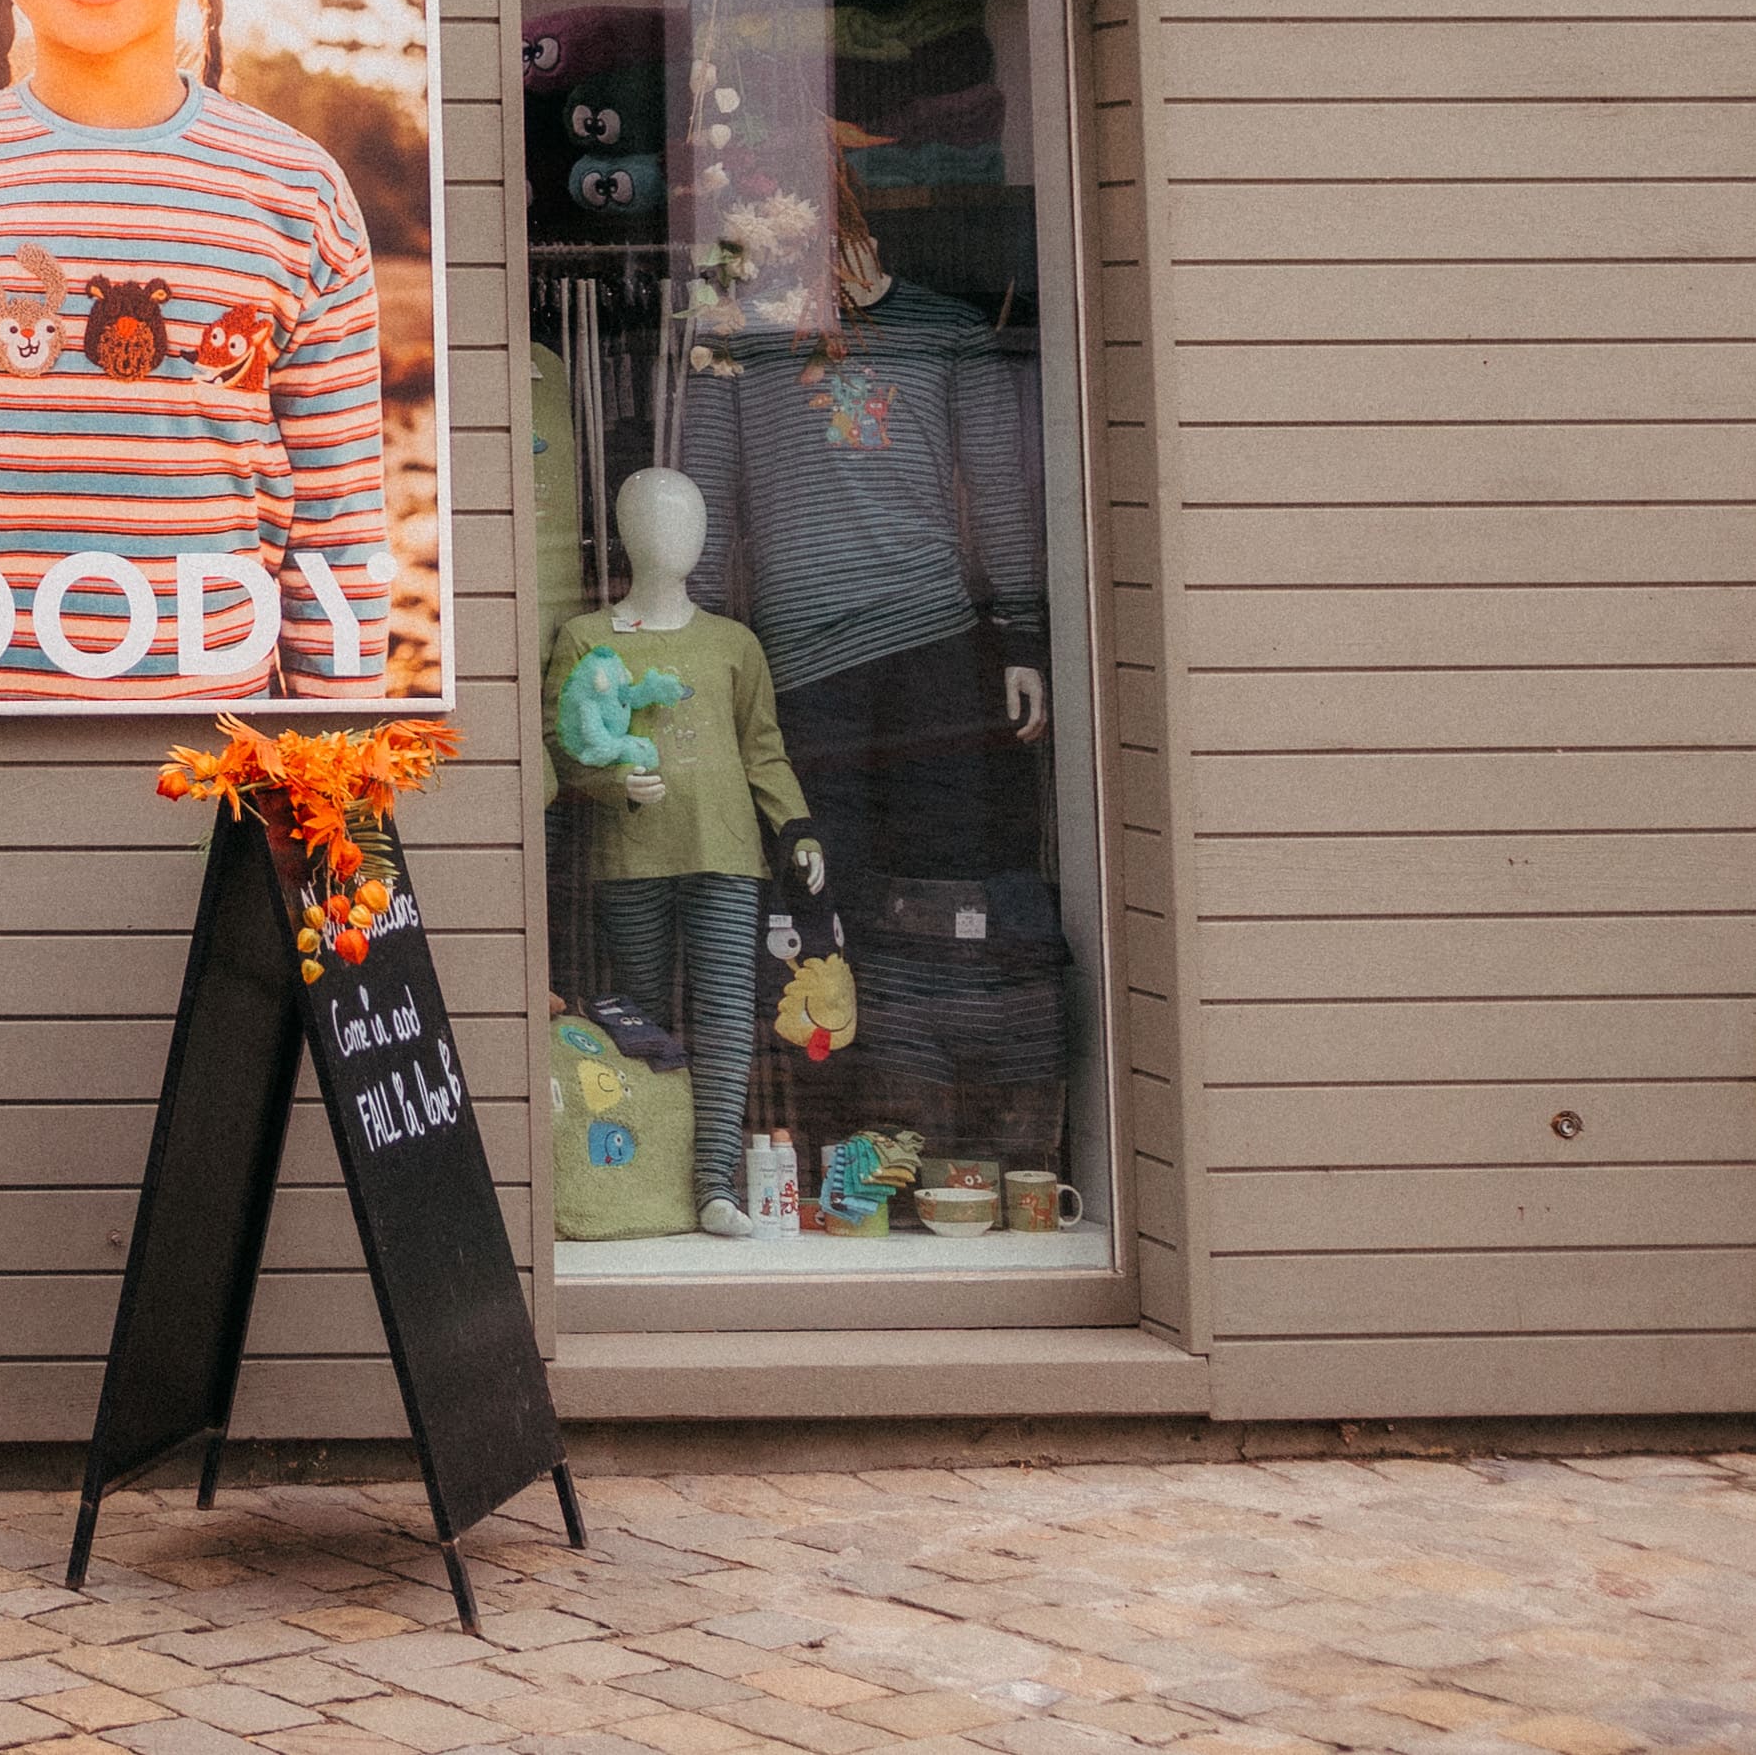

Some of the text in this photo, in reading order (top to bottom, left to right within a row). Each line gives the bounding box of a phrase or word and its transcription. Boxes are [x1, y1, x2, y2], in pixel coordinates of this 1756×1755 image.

[331, 998, 372, 1057] Come
[392, 984, 421, 1041] and
[356, 1059, 458, 1152] FALL in love
